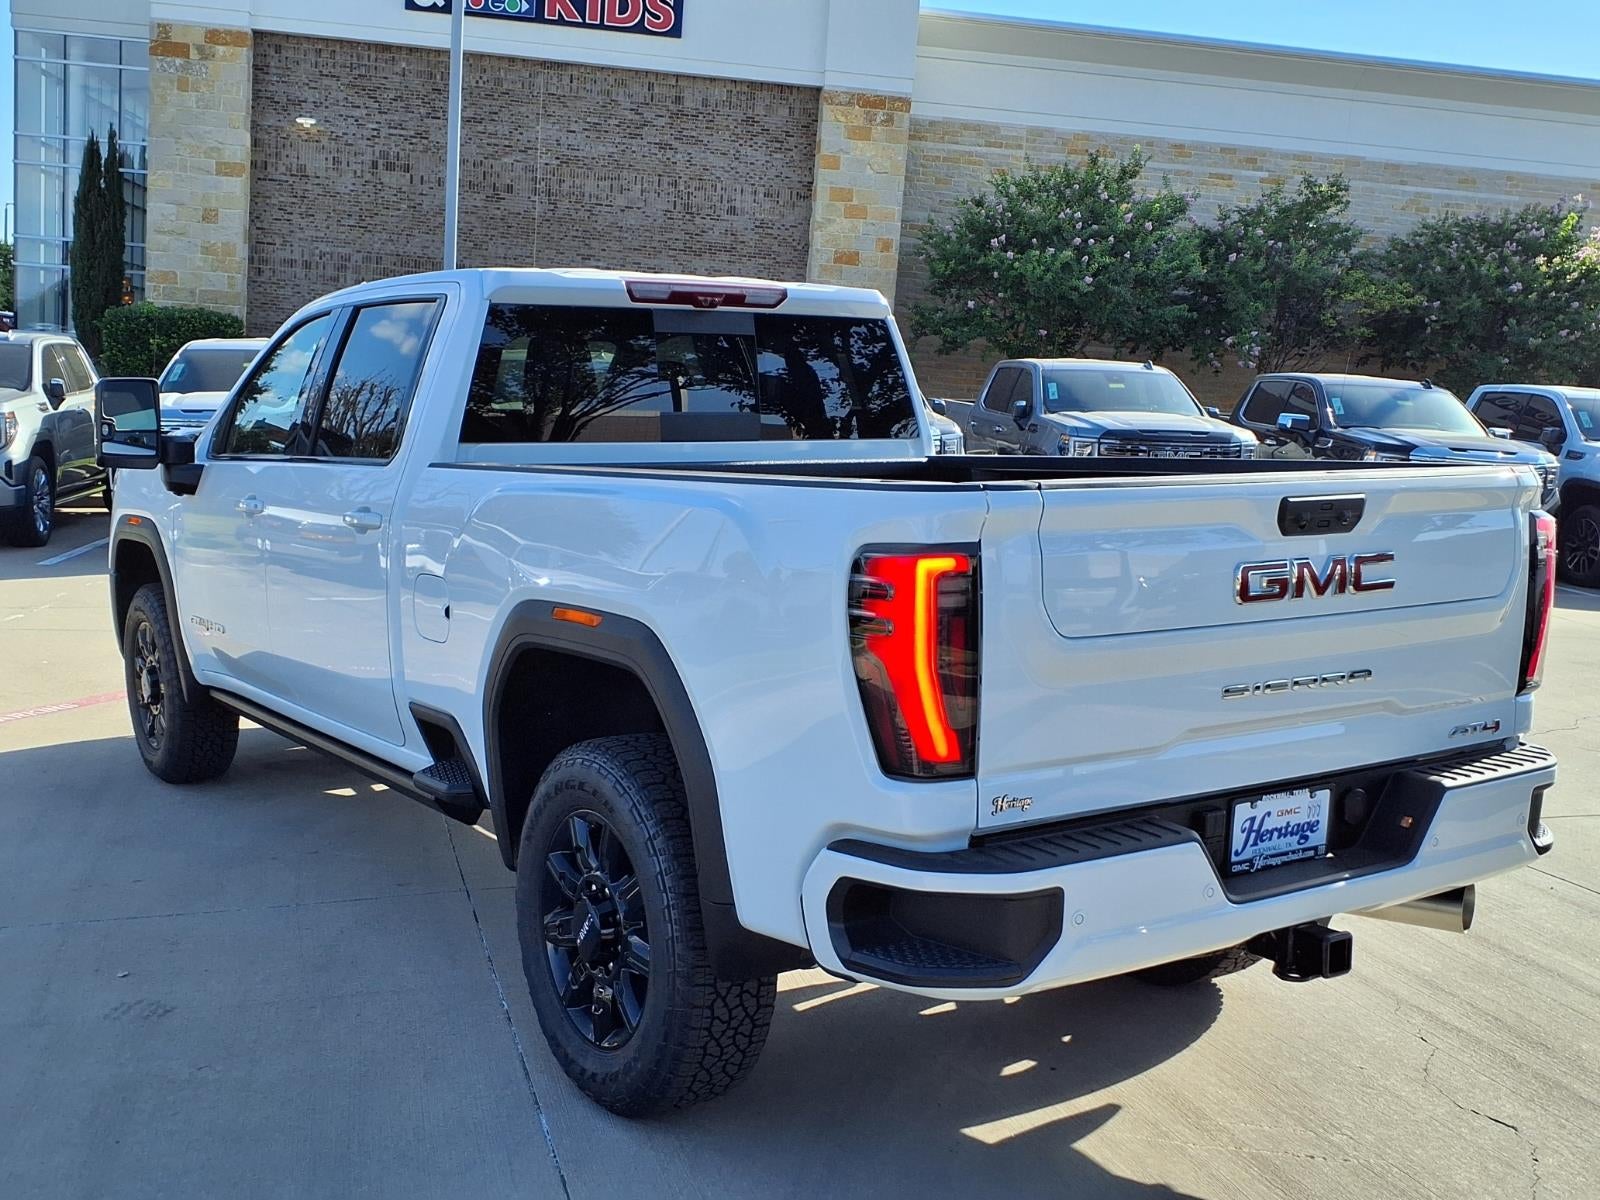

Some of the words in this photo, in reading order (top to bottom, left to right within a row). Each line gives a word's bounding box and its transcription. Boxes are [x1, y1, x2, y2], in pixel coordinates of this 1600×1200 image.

[1233, 551, 1396, 605] GMC
[1221, 668, 1373, 700] SIERRA
[1447, 718, 1501, 738] AT4
[1276, 806, 1301, 817] GMC
[1234, 810, 1320, 857] Heritage
[1231, 862, 1250, 873] GMC
